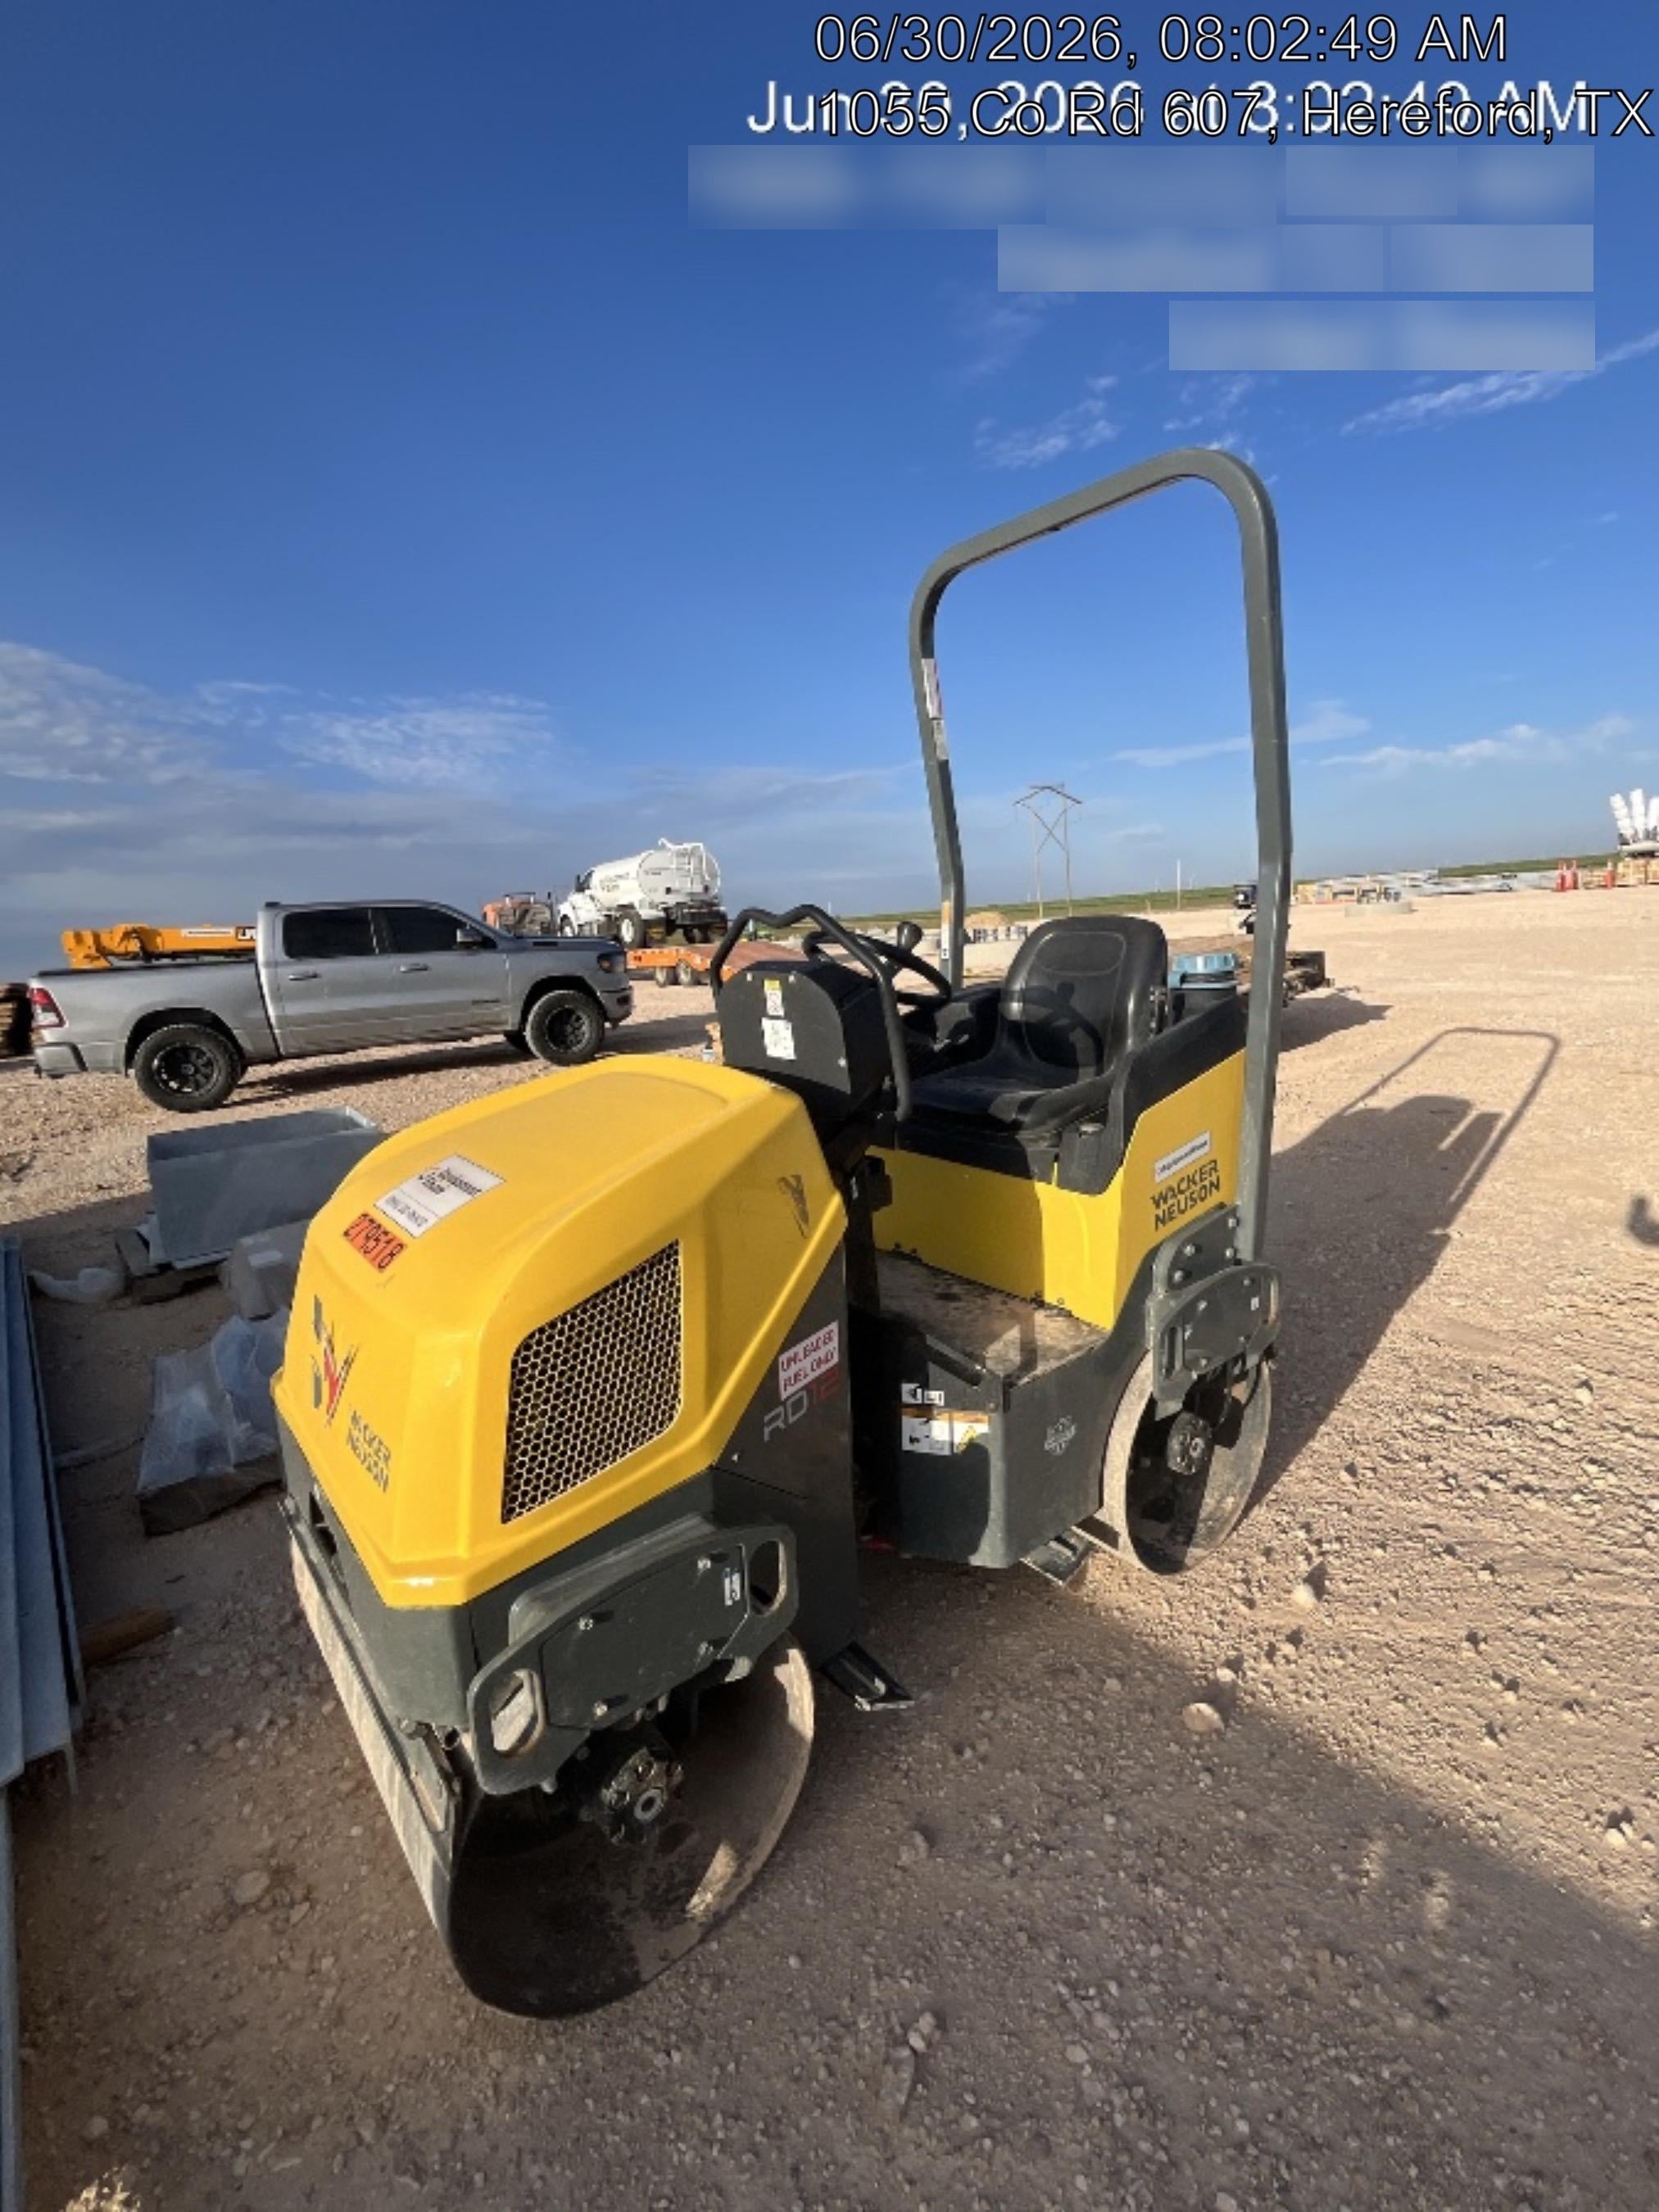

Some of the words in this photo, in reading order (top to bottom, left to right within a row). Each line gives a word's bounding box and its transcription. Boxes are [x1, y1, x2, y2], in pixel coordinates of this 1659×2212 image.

[1149, 1158, 1220, 1210] WACKER
[1154, 1174, 1221, 1232] NEUSON
[782, 1368, 809, 1392] FUEL
